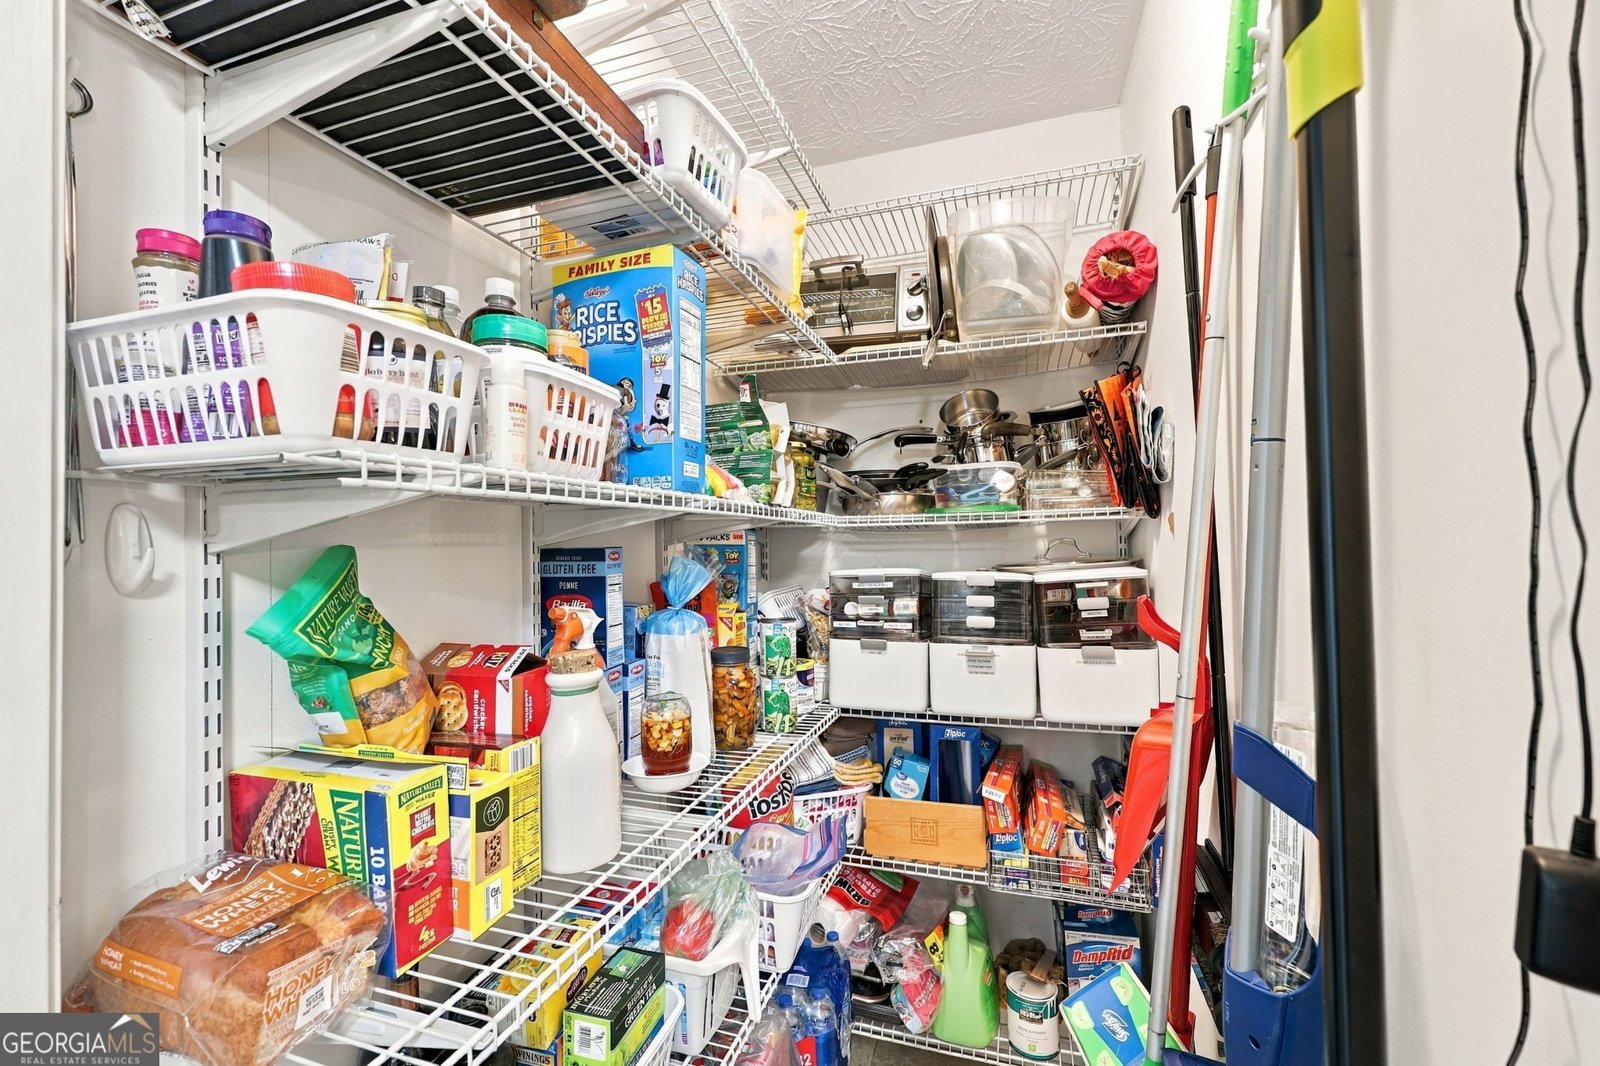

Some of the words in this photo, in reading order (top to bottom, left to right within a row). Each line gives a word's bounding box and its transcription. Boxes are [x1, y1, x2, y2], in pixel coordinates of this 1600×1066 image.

[568, 260, 615, 278] FAMILY
[619, 253, 651, 268] SIZE
[576, 302, 618, 328] RICE
[543, 564, 574, 574] GLUTEN
[577, 563, 596, 574] FREE
[306, 593, 344, 643] NATURE
[483, 652, 509, 668] RITZ
[944, 728, 966, 738] Ziploc
[321, 817, 331, 851] CREAMY
[327, 820, 337, 849] CRISPY
[333, 796, 364, 882] NATURE
[995, 834, 1018, 844] Ziploc
[370, 847, 385, 868] 10
[193, 882, 276, 924] HONEY
[203, 887, 286, 928] WHEAT
[102, 946, 124, 961] HONEY
[1072, 945, 1134, 965] DampRid
[264, 952, 341, 1008] HONEY
[624, 1000, 646, 1028] GREEN
[644, 983, 657, 1002] TEA
[1104, 1012, 1129, 1040] Swiffer
[514, 1048, 551, 1066] WININGS
